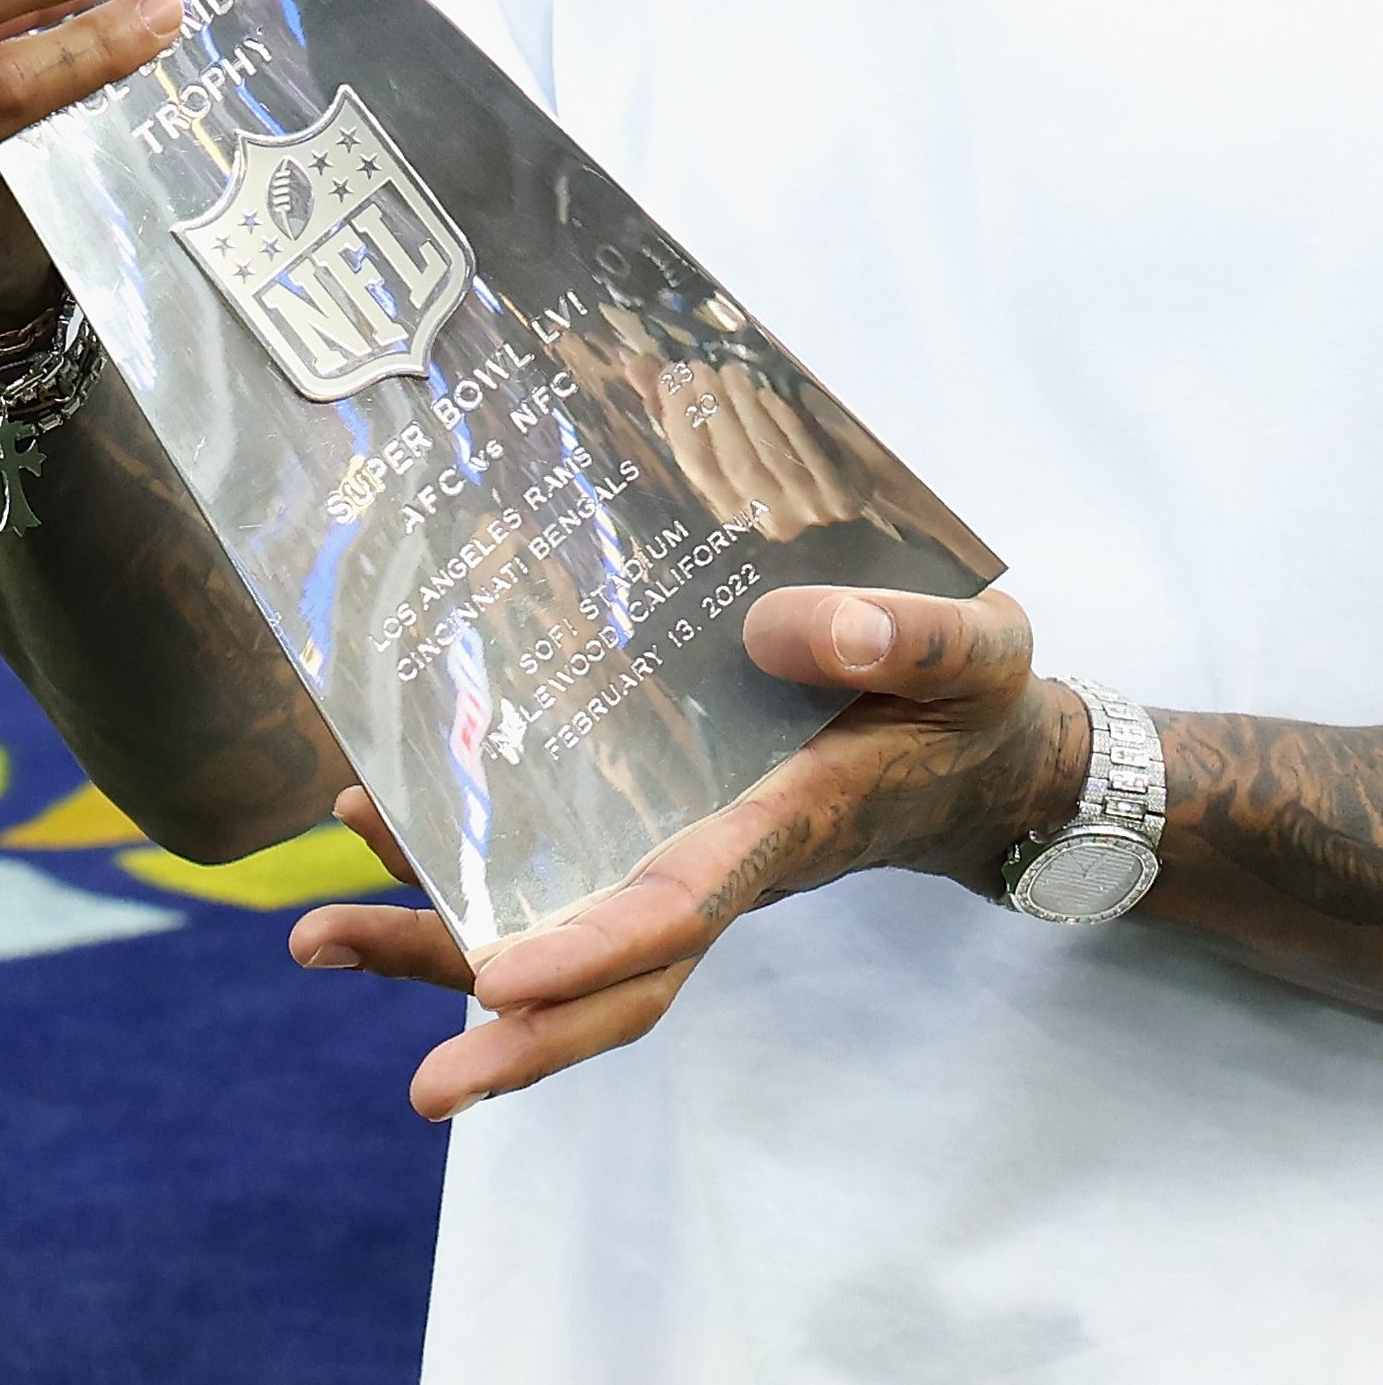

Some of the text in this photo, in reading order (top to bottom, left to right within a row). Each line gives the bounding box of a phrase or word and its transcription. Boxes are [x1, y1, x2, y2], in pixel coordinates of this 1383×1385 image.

[130, 27, 273, 155] TROPHY
[260, 202, 448, 376] NFL
[323, 288, 589, 525] SUPER BOWL LVI
[400, 468, 466, 535] AFC
[509, 371, 578, 434] NFC
[369, 361, 694, 652] LOS ANGELES RAMS 23
[396, 393, 718, 682] CINCINNATI BENGALS 20
[629, 498, 770, 623] CALIFORNIA
[519, 519, 690, 675] SOFI STADIUM
[543, 644, 664, 761] FEBRUARY
[700, 562, 762, 619] 2022
